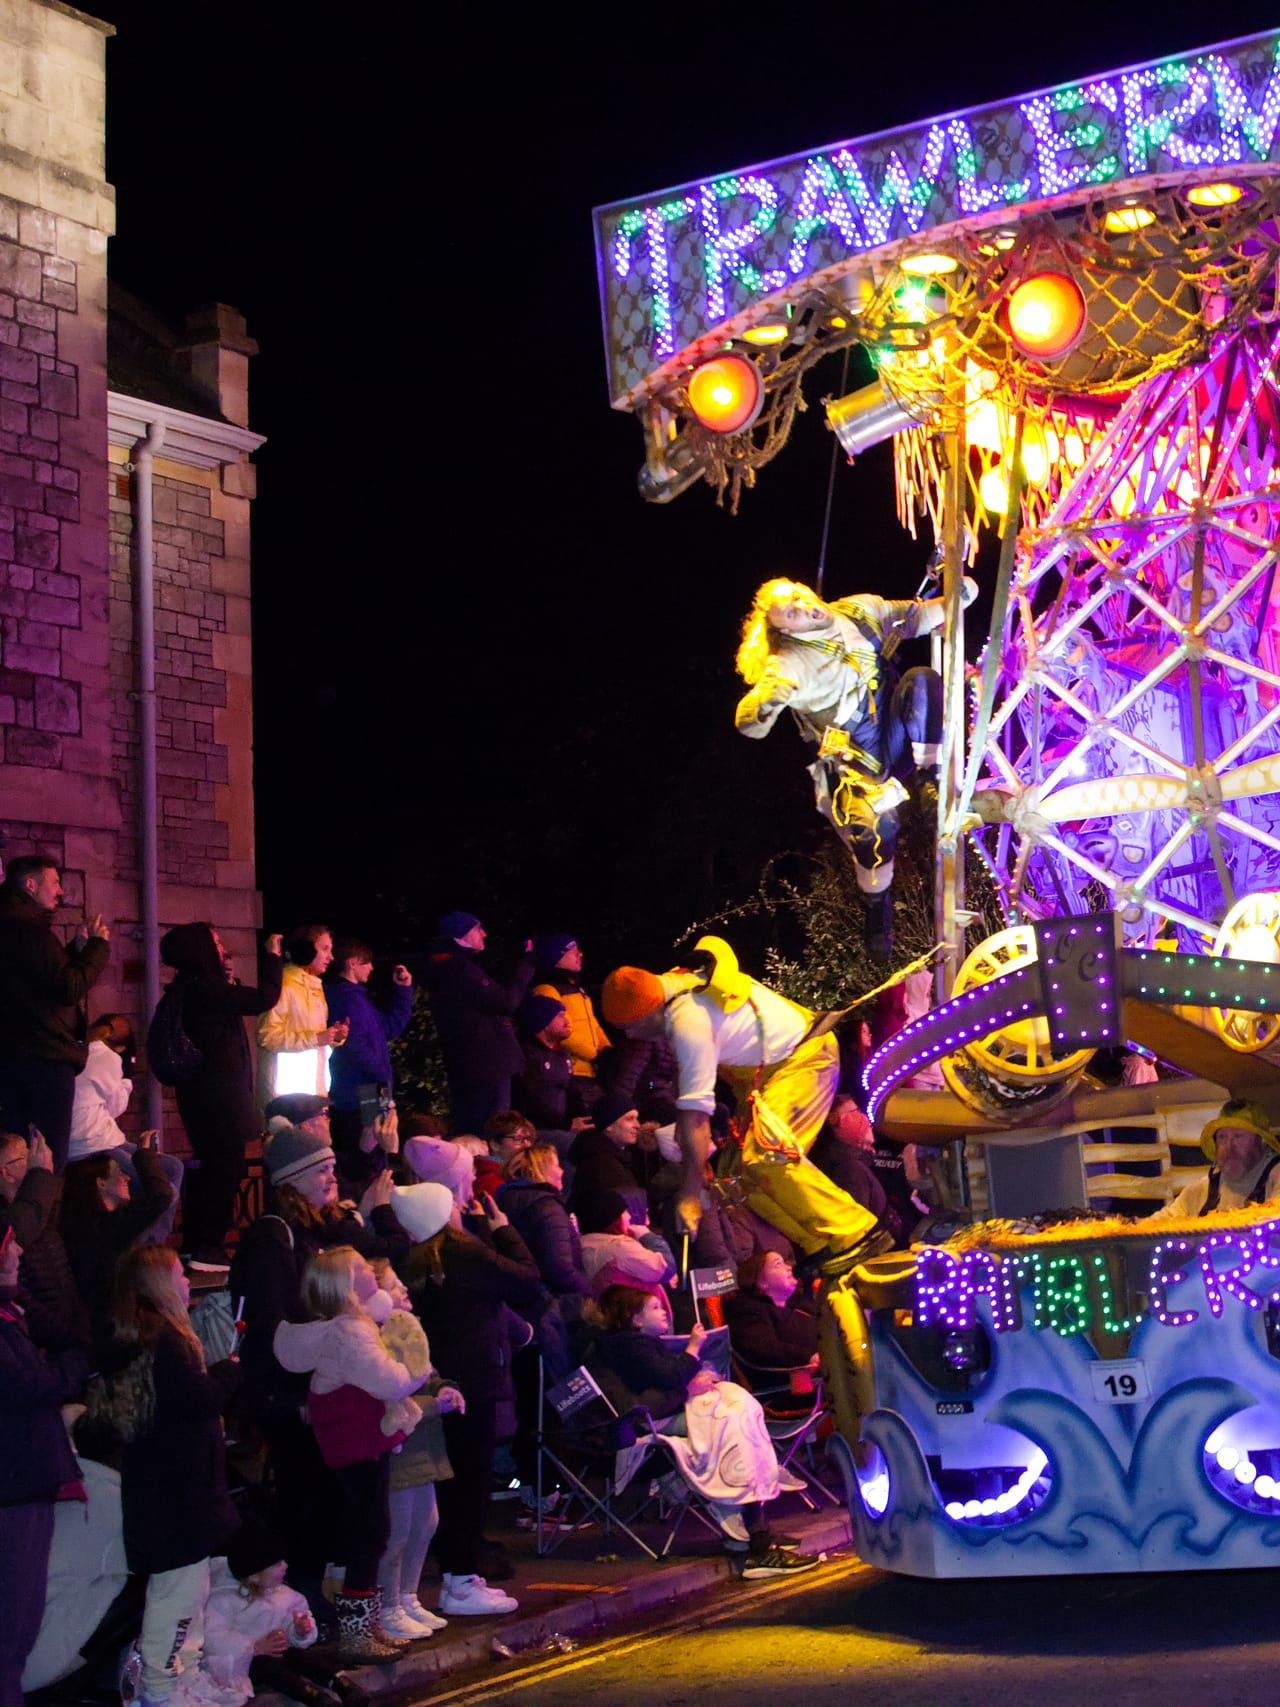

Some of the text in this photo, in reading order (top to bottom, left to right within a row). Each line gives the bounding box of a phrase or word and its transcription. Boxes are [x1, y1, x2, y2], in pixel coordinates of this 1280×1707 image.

[698, 1278, 735, 1291] Lifeboats
[1104, 1374, 1137, 1397] 19
[556, 1385, 592, 1411] Lifeboats
